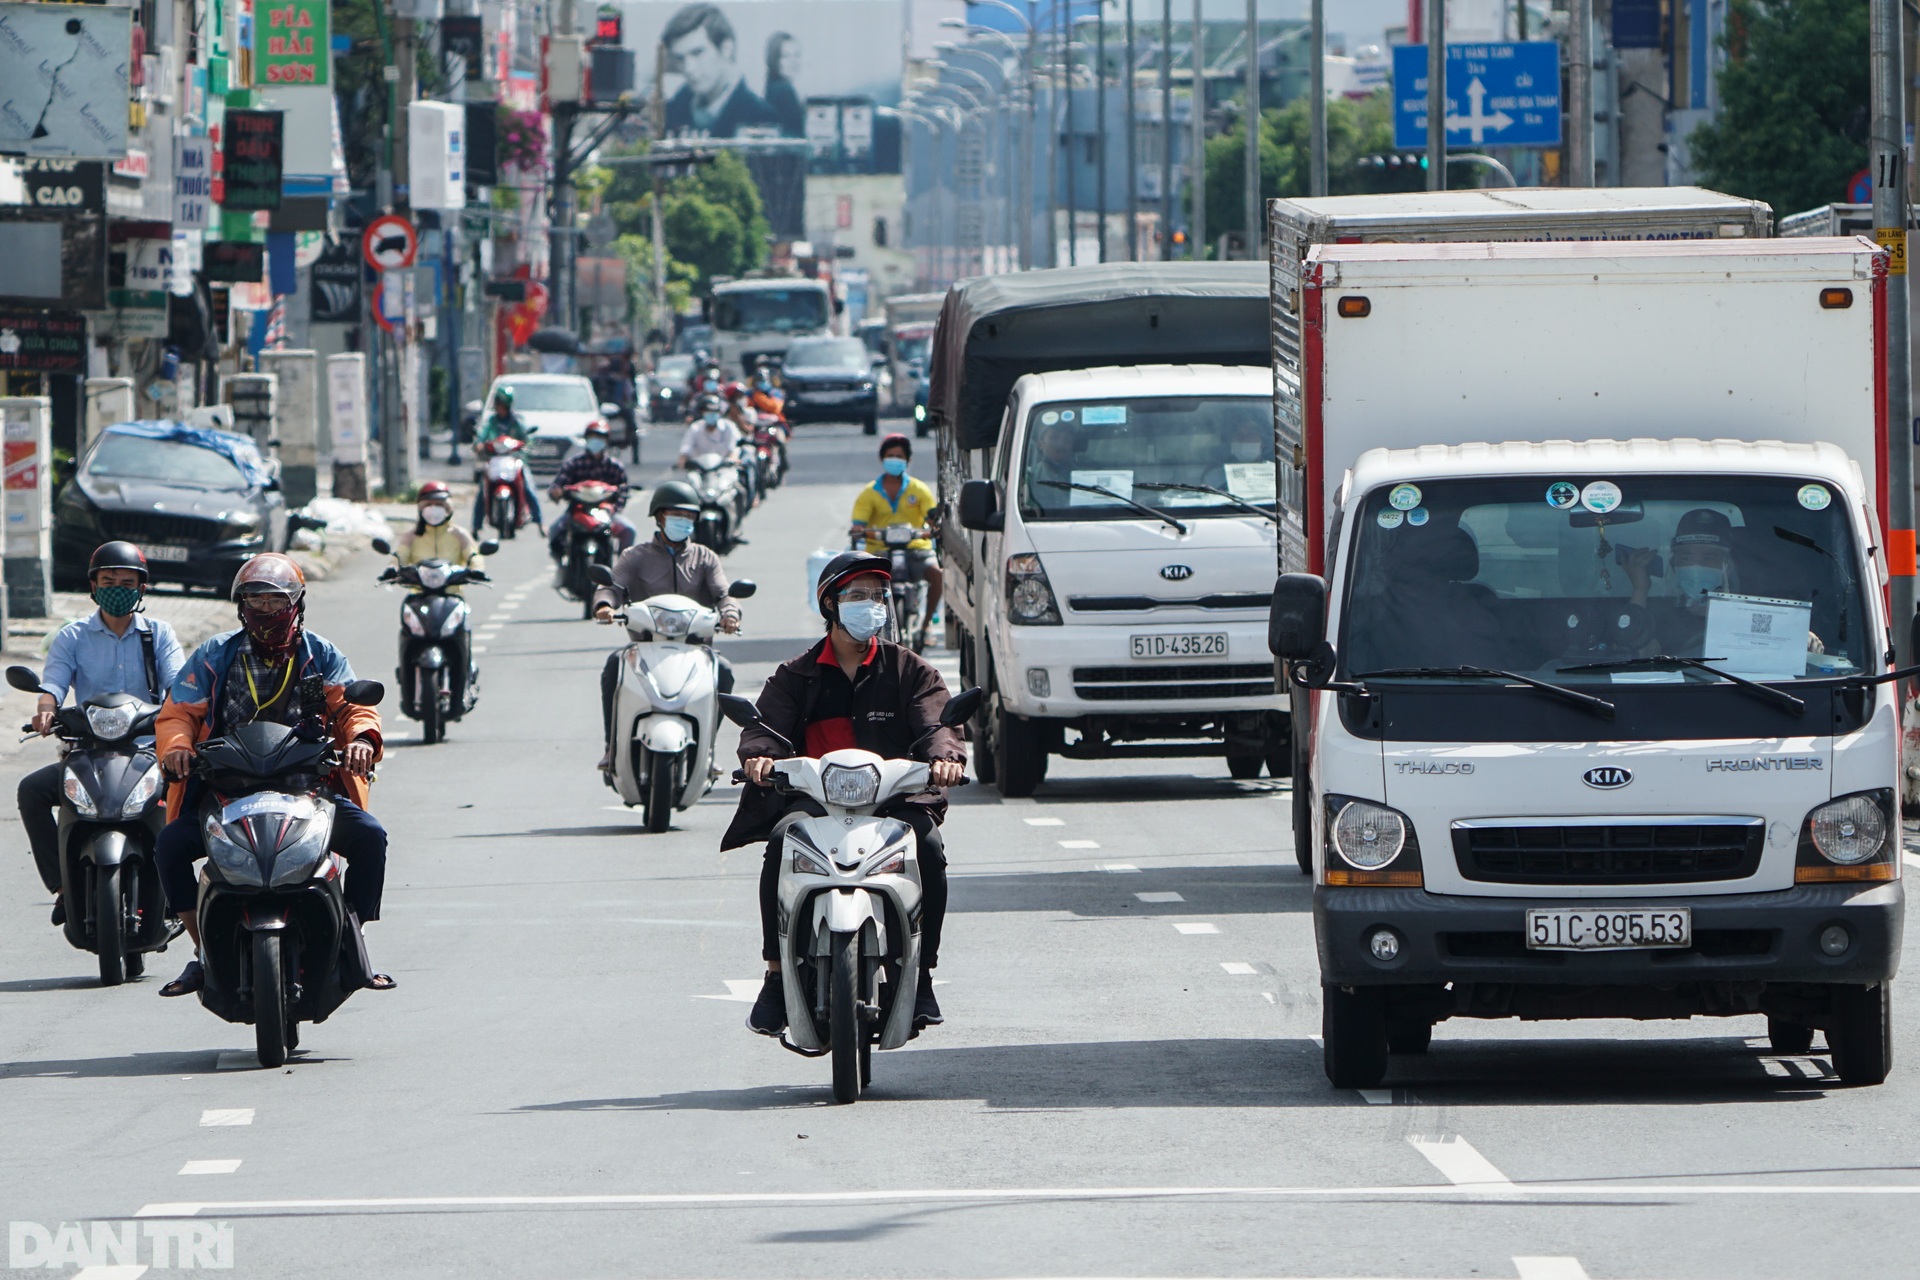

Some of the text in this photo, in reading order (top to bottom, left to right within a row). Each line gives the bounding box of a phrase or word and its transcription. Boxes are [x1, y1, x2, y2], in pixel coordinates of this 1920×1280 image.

[36, 185, 84, 206] CAO
[1164, 566, 1189, 578] KIA
[1394, 761, 1475, 775] THACO
[1706, 757, 1823, 772] FRONTIER
[1590, 768, 1625, 785] KIA
